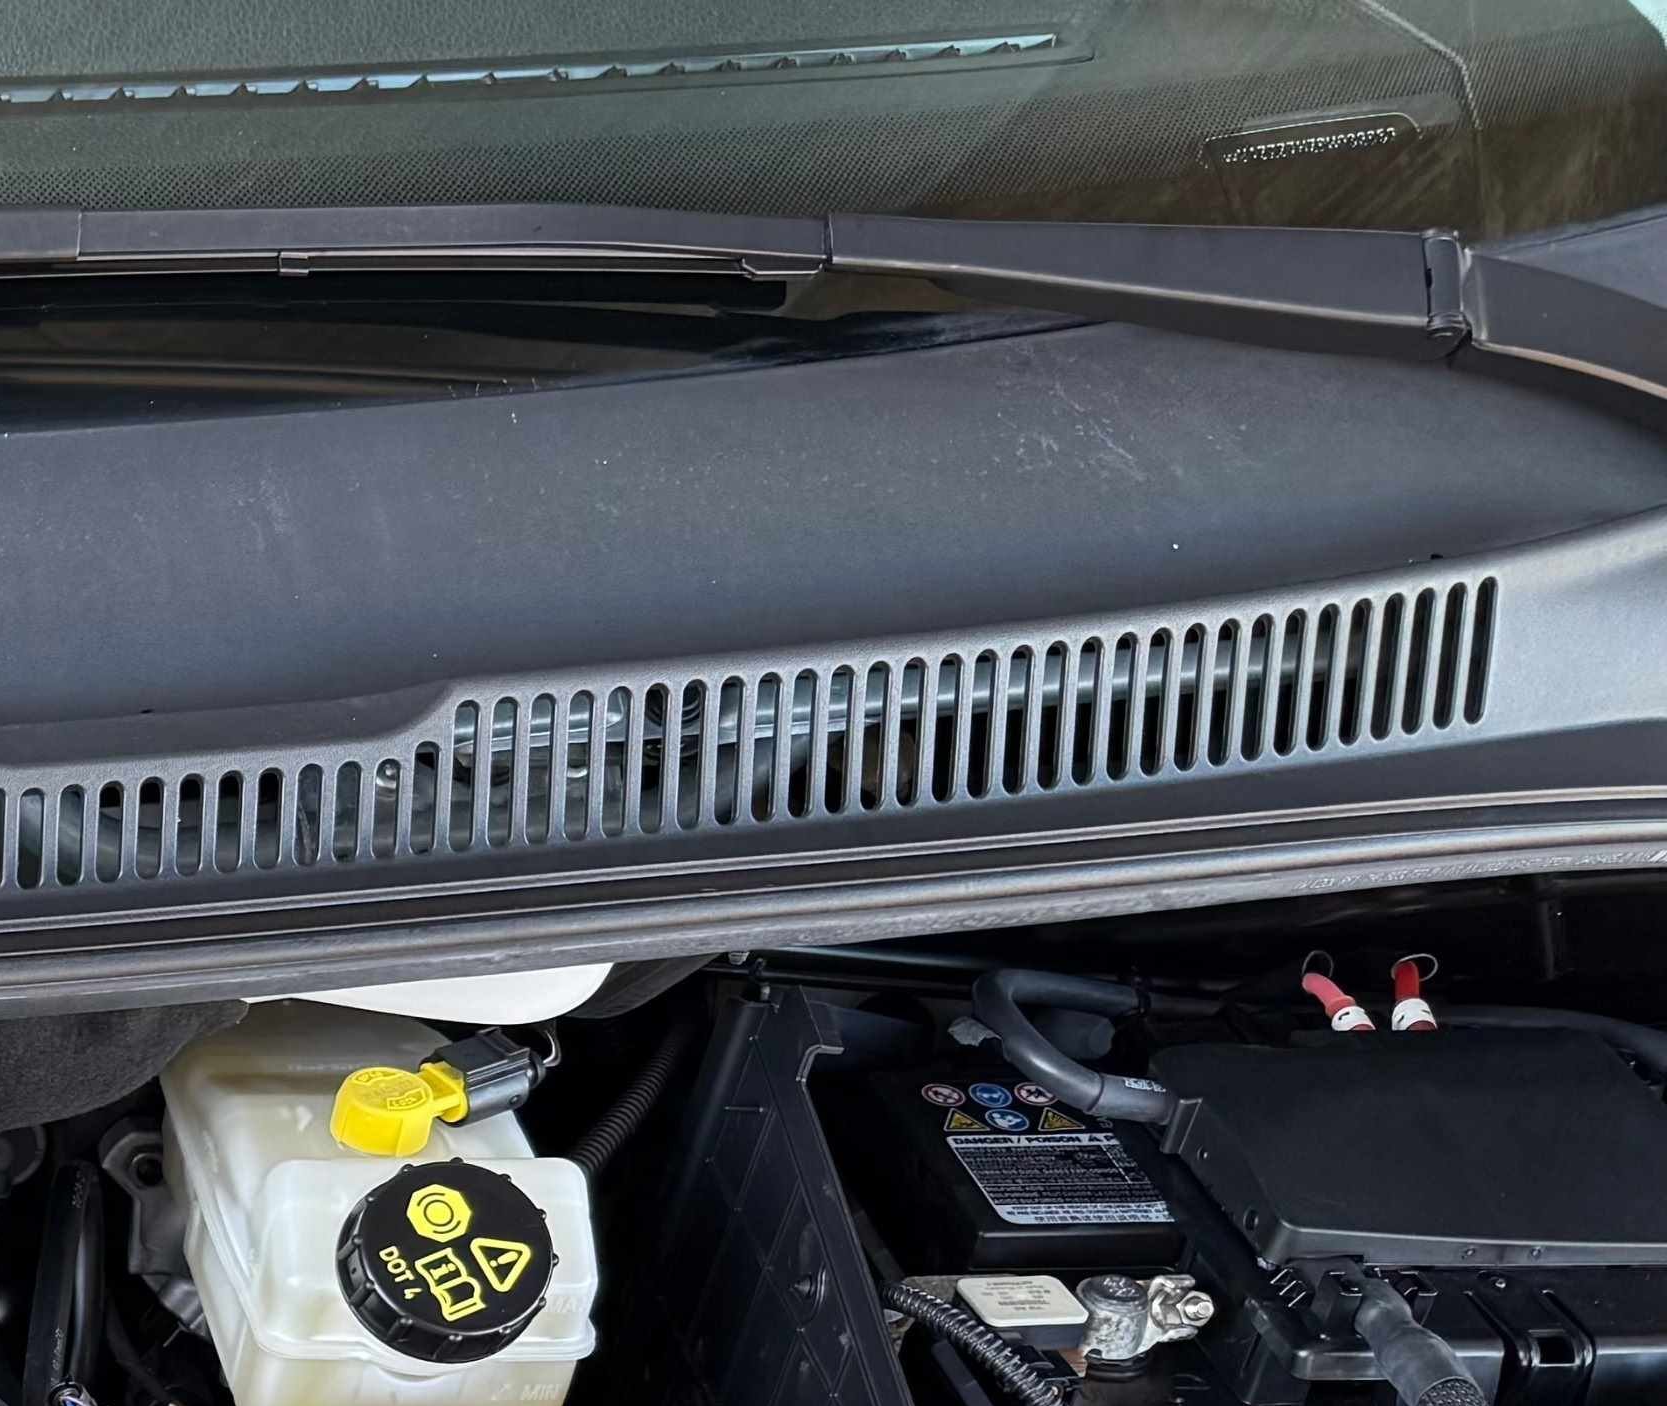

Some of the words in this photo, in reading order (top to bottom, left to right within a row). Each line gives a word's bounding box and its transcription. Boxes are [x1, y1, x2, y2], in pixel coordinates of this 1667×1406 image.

[379, 1245, 415, 1283] DOT
[403, 1286, 422, 1300] 4
[520, 1383, 563, 1401] MIN
